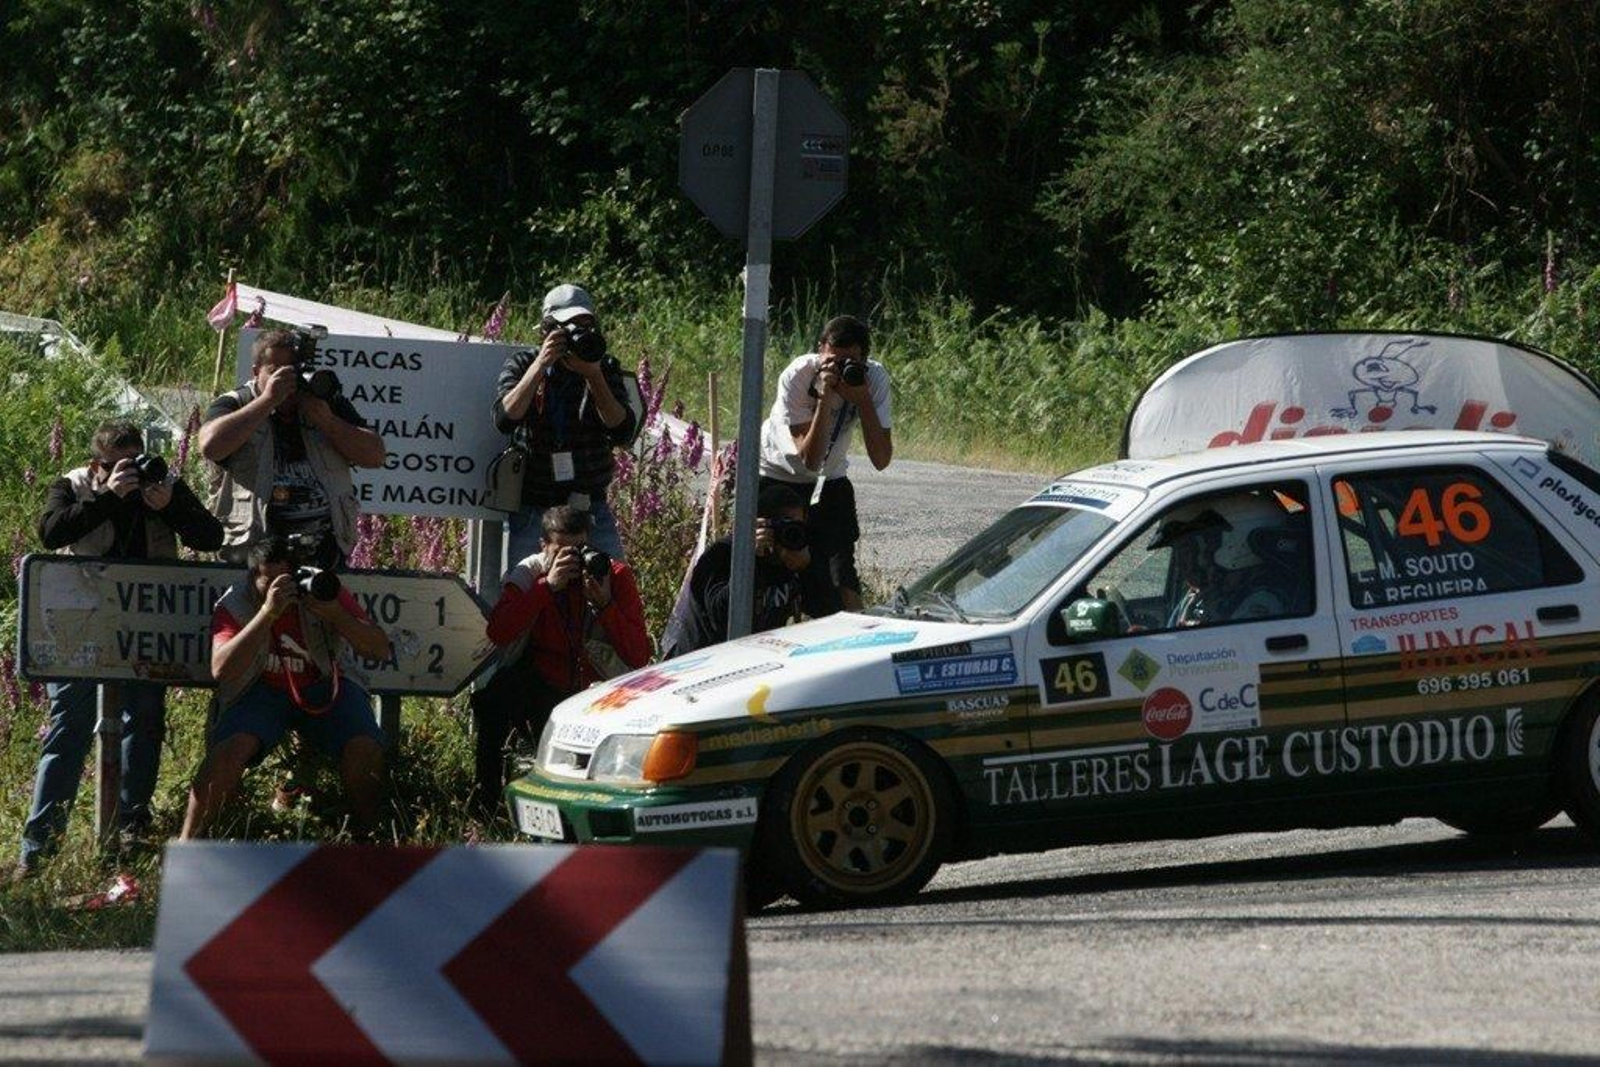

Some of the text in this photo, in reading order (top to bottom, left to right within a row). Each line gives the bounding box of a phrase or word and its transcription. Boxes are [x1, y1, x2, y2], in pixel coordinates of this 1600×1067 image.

[365, 414, 454, 440] HALÁN
[383, 452, 475, 474] GOSTO
[1398, 482, 1491, 547] 46
[1405, 552, 1475, 577] SOUTO
[354, 592, 400, 625] XO
[435, 596, 445, 626] 1
[1351, 607, 1459, 631] TRANSPORTES
[116, 625, 208, 664] VENTÍ
[428, 644, 444, 674] 2
[1166, 647, 1236, 665] Deputación
[1054, 659, 1098, 695] 46
[1417, 667, 1530, 695] 696 395 061
[983, 714, 1495, 806] TALLERES LAGE CUSTODIO
[637, 807, 733, 828] AUTOMOTOGAS
